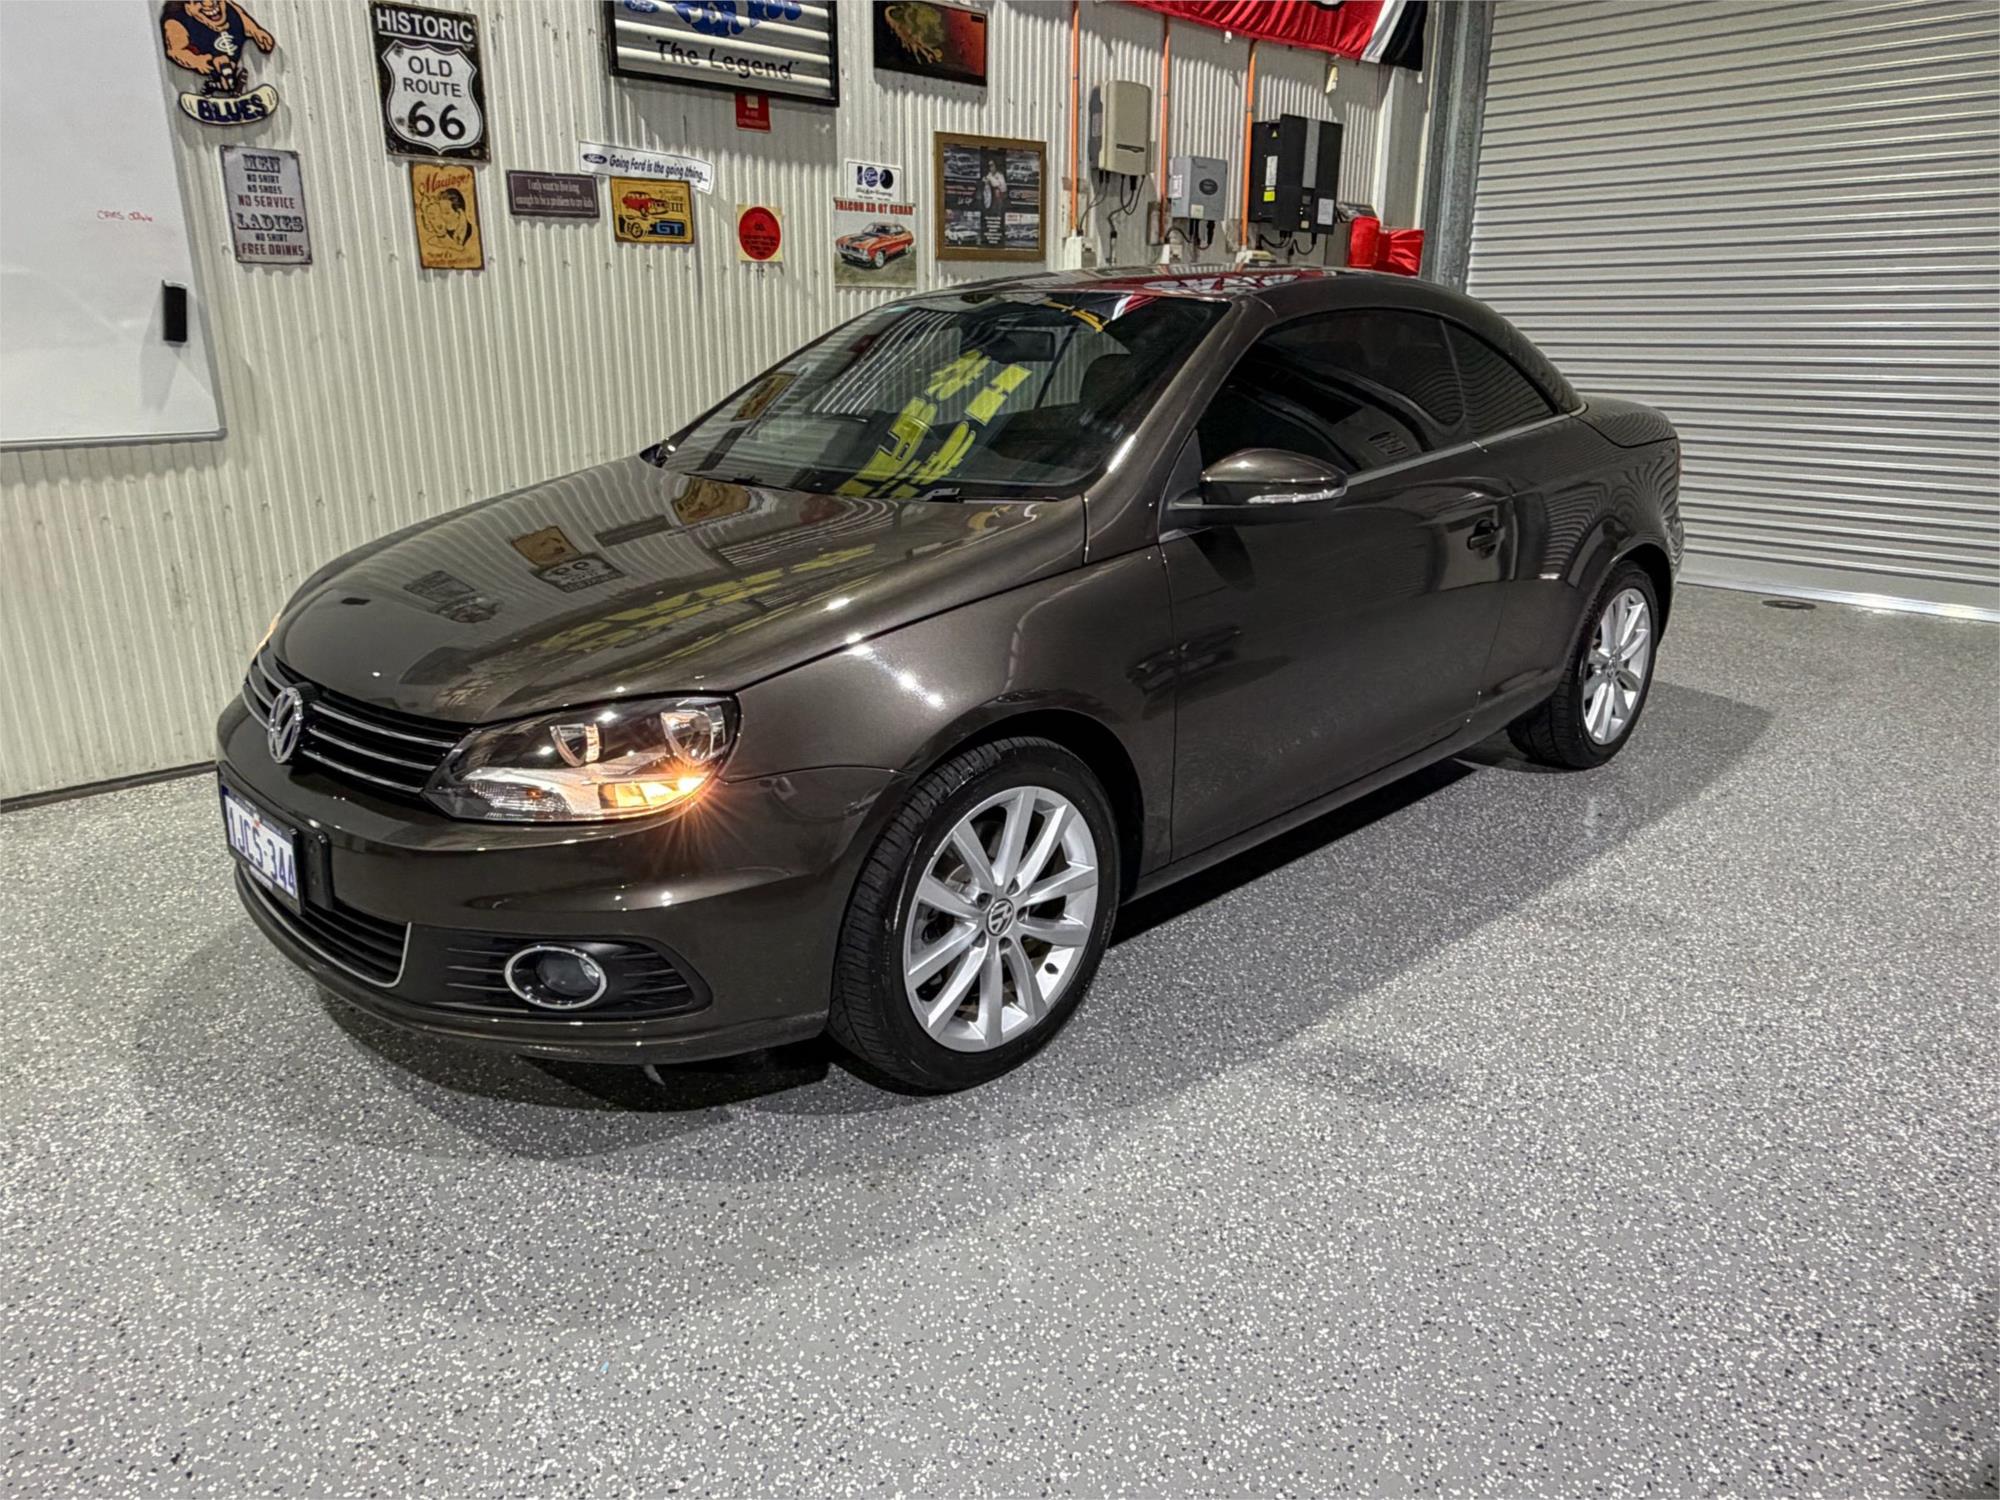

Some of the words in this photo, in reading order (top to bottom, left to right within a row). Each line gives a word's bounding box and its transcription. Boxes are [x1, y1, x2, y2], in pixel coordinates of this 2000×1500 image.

[376, 8, 474, 42] HISTORIC
[408, 56, 453, 78] OLD
[402, 77, 462, 98] ROUTE
[197, 94, 269, 122] BLUES
[407, 100, 466, 140] 66
[242, 154, 281, 173] MEN
[609, 154, 630, 173] Going
[631, 157, 646, 171] Ford
[647, 159, 653, 172] is
[654, 160, 664, 174] the
[666, 163, 684, 180] going
[246, 174, 257, 183] NO
[258, 174, 280, 184] SHIRT
[247, 184, 257, 193] NO
[259, 185, 282, 194] SHOES
[237, 194, 252, 207] NO
[254, 195, 295, 209] SERVICE
[835, 200, 864, 212] FALCON
[878, 203, 888, 214] GT
[236, 212, 304, 233] LADIES
[656, 222, 683, 235] GT
[255, 233, 265, 242] NO
[266, 233, 288, 243] SHIRT
[242, 243, 266, 255] FREE
[268, 243, 304, 256] DRINKS
